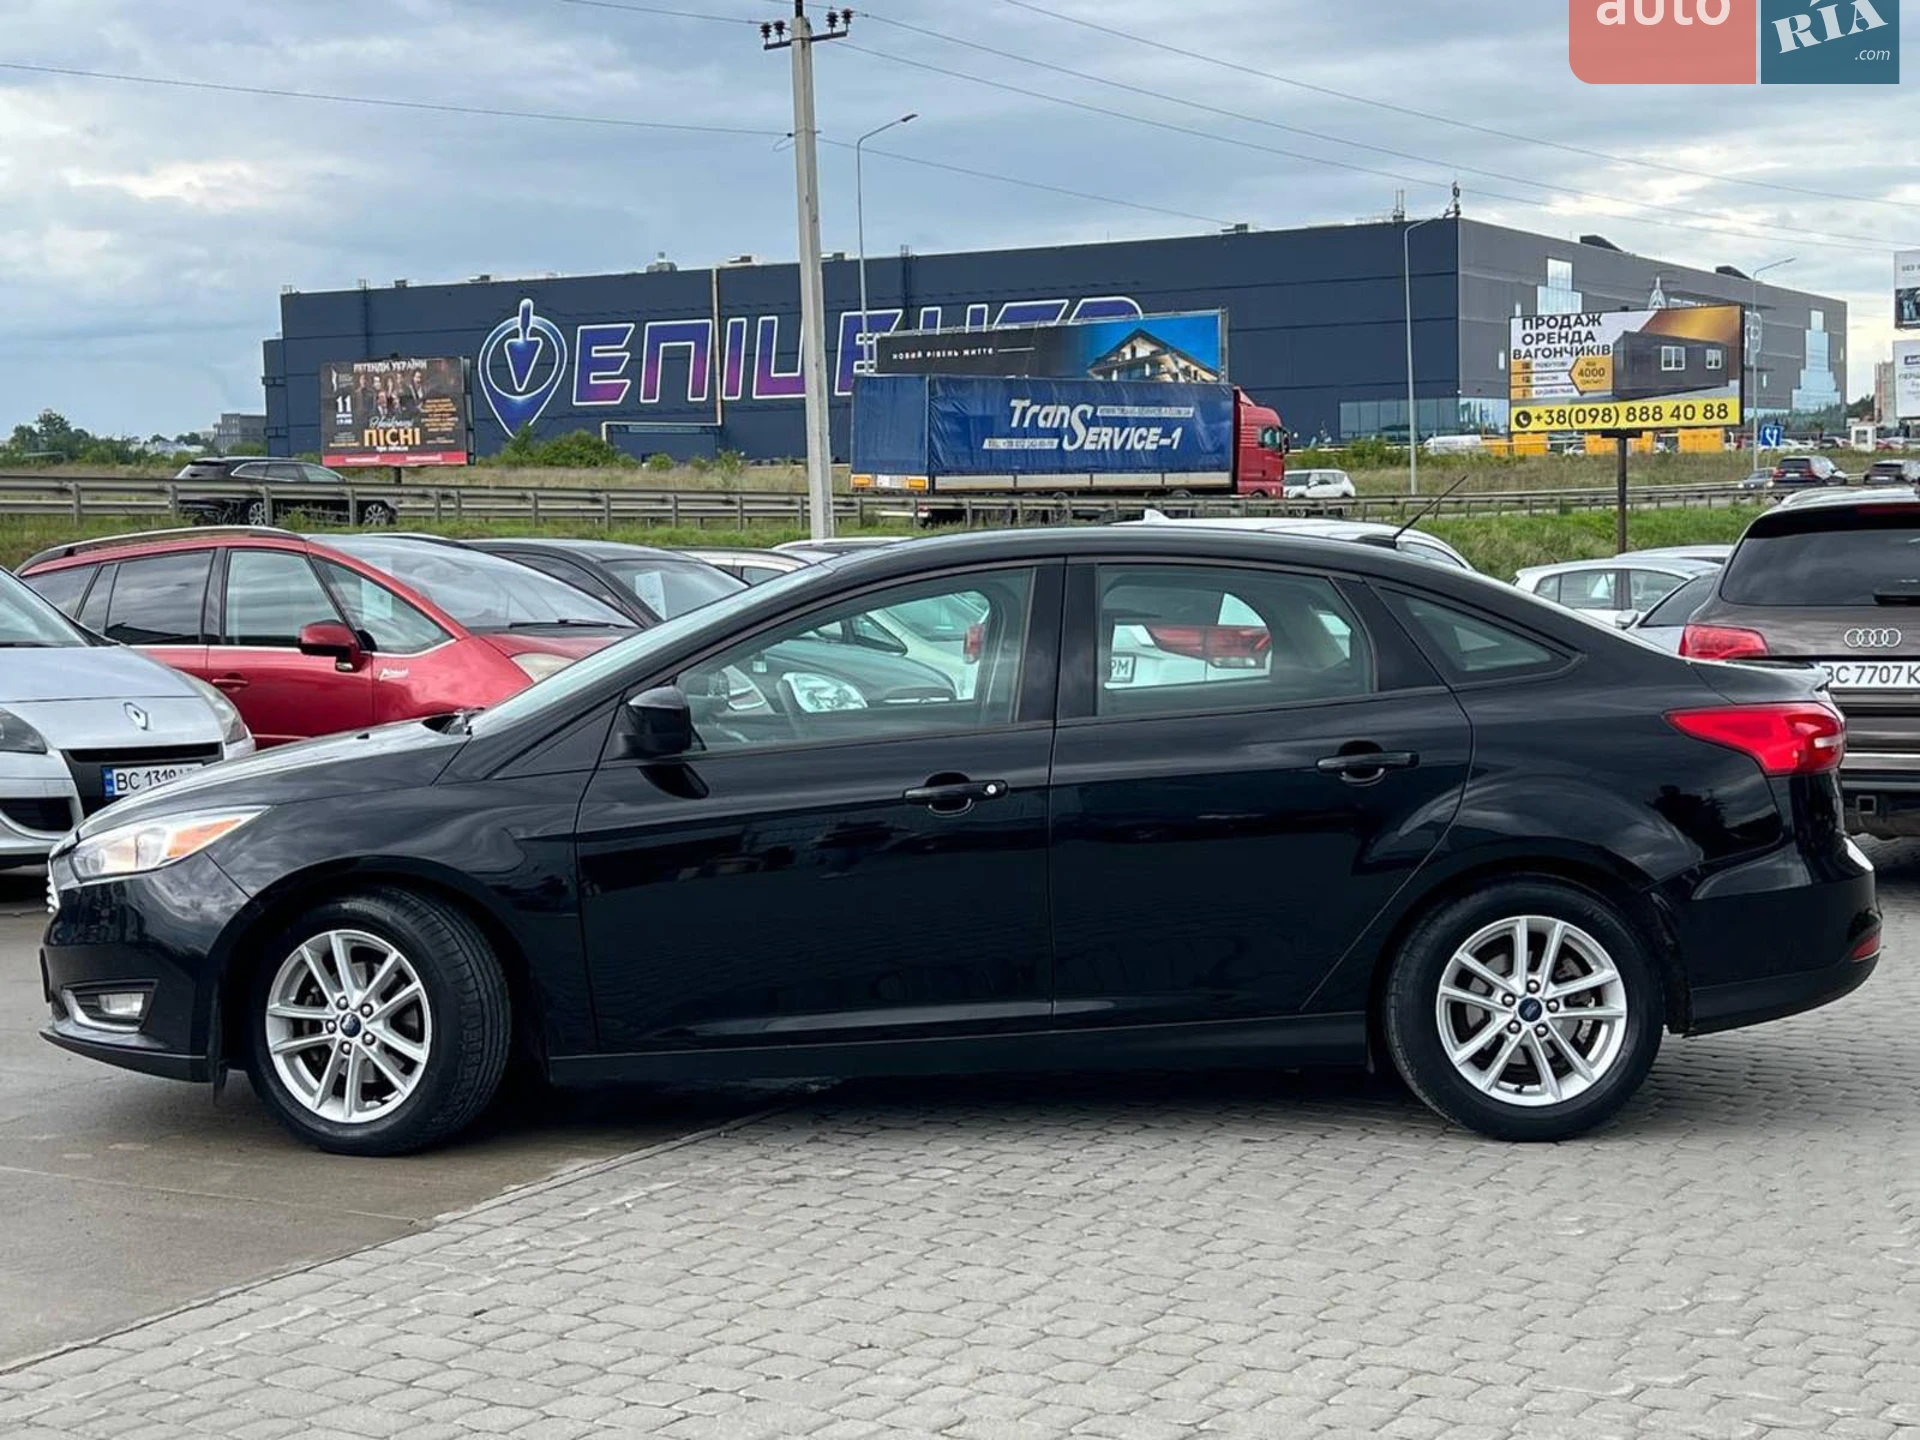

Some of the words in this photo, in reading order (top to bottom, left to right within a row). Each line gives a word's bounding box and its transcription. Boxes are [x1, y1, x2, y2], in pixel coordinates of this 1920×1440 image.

[1521, 313, 1602, 330] ПРОДАЖ
[1521, 330, 1596, 346] ОРЕНДА
[1512, 344, 1611, 360] ВАГОНЧИКІВ
[1577, 367, 1606, 378] 4000
[335, 395, 352, 413] 11
[1534, 406, 1620, 428] +38(098)
[1625, 405, 1663, 422] 888
[1670, 404, 1696, 421] 40
[1702, 402, 1729, 420] 88
[364, 427, 421, 447] ПІСНІ
[1855, 665, 1903, 684] 7707
[116, 772, 140, 791] BC
